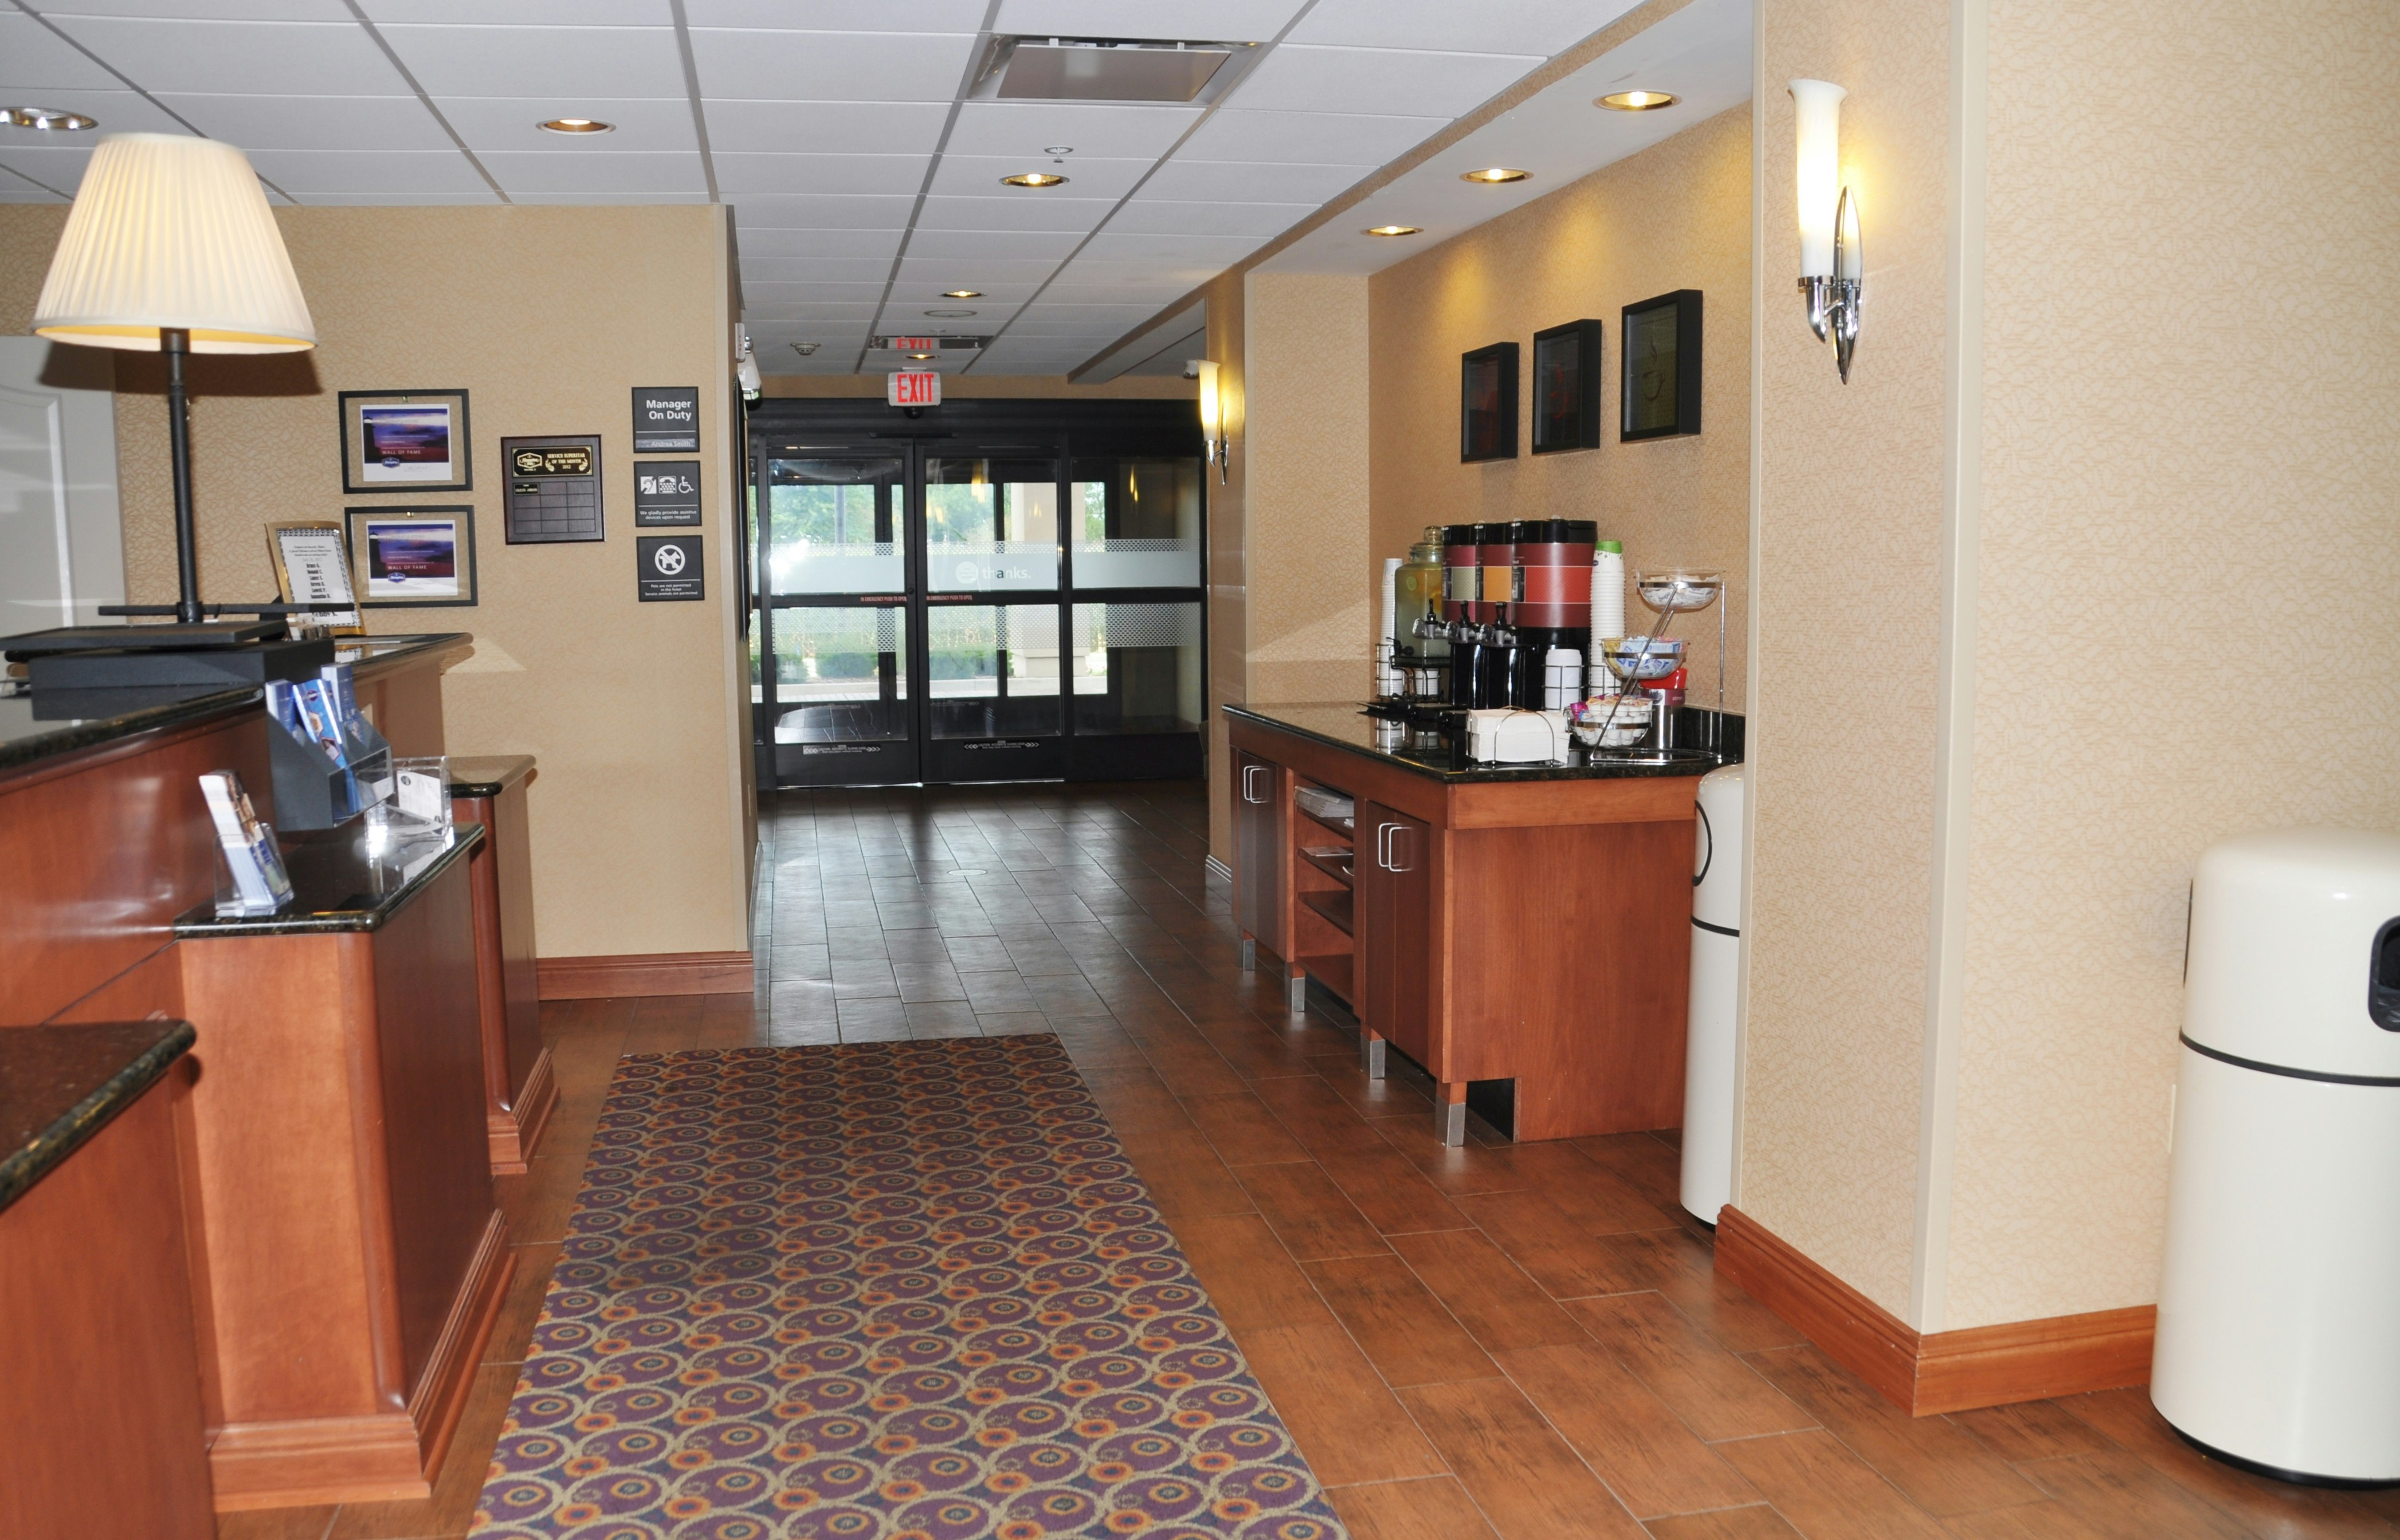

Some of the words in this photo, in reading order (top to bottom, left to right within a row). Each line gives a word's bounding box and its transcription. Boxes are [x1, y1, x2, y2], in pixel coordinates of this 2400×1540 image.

[897, 374, 934, 403] EXIT
[646, 399, 692, 410] Manager
[649, 411, 664, 419] On
[667, 411, 692, 421] Duty
[982, 566, 1031, 579] thanks.
